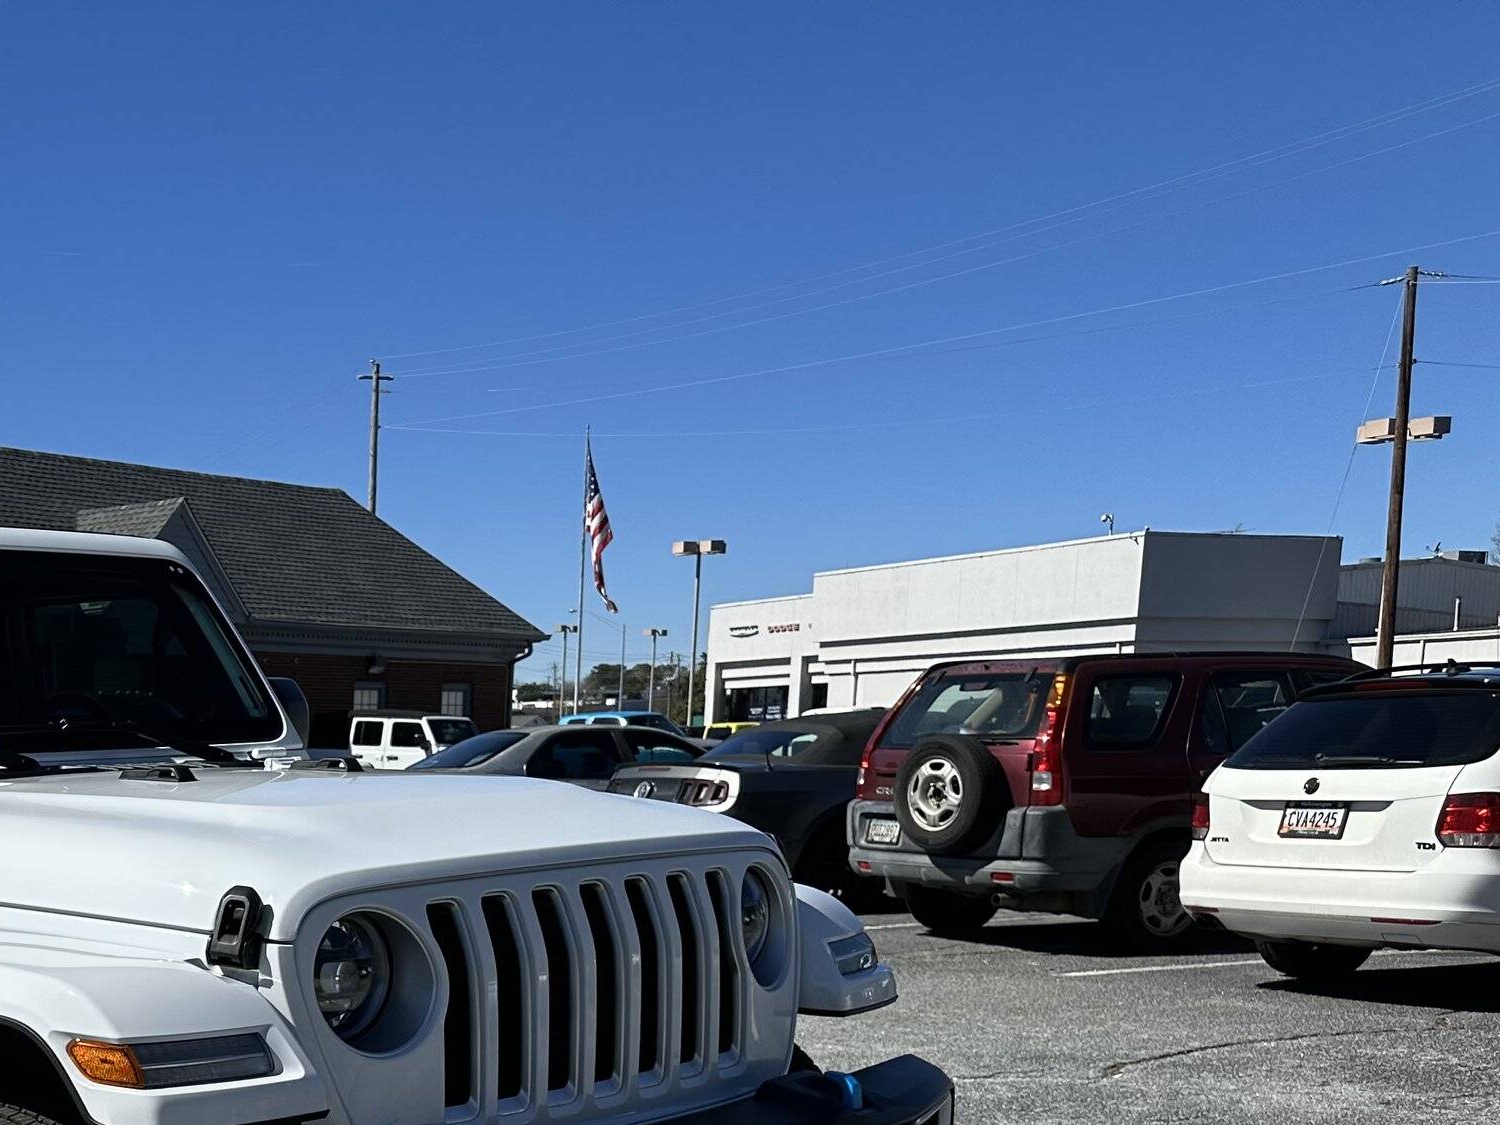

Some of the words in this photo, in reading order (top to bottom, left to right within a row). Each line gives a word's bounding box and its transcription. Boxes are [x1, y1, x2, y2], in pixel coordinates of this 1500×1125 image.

[767, 624, 800, 634] DODGE
[1288, 811, 1339, 829] CVA4245
[1415, 841, 1436, 851] TDI
